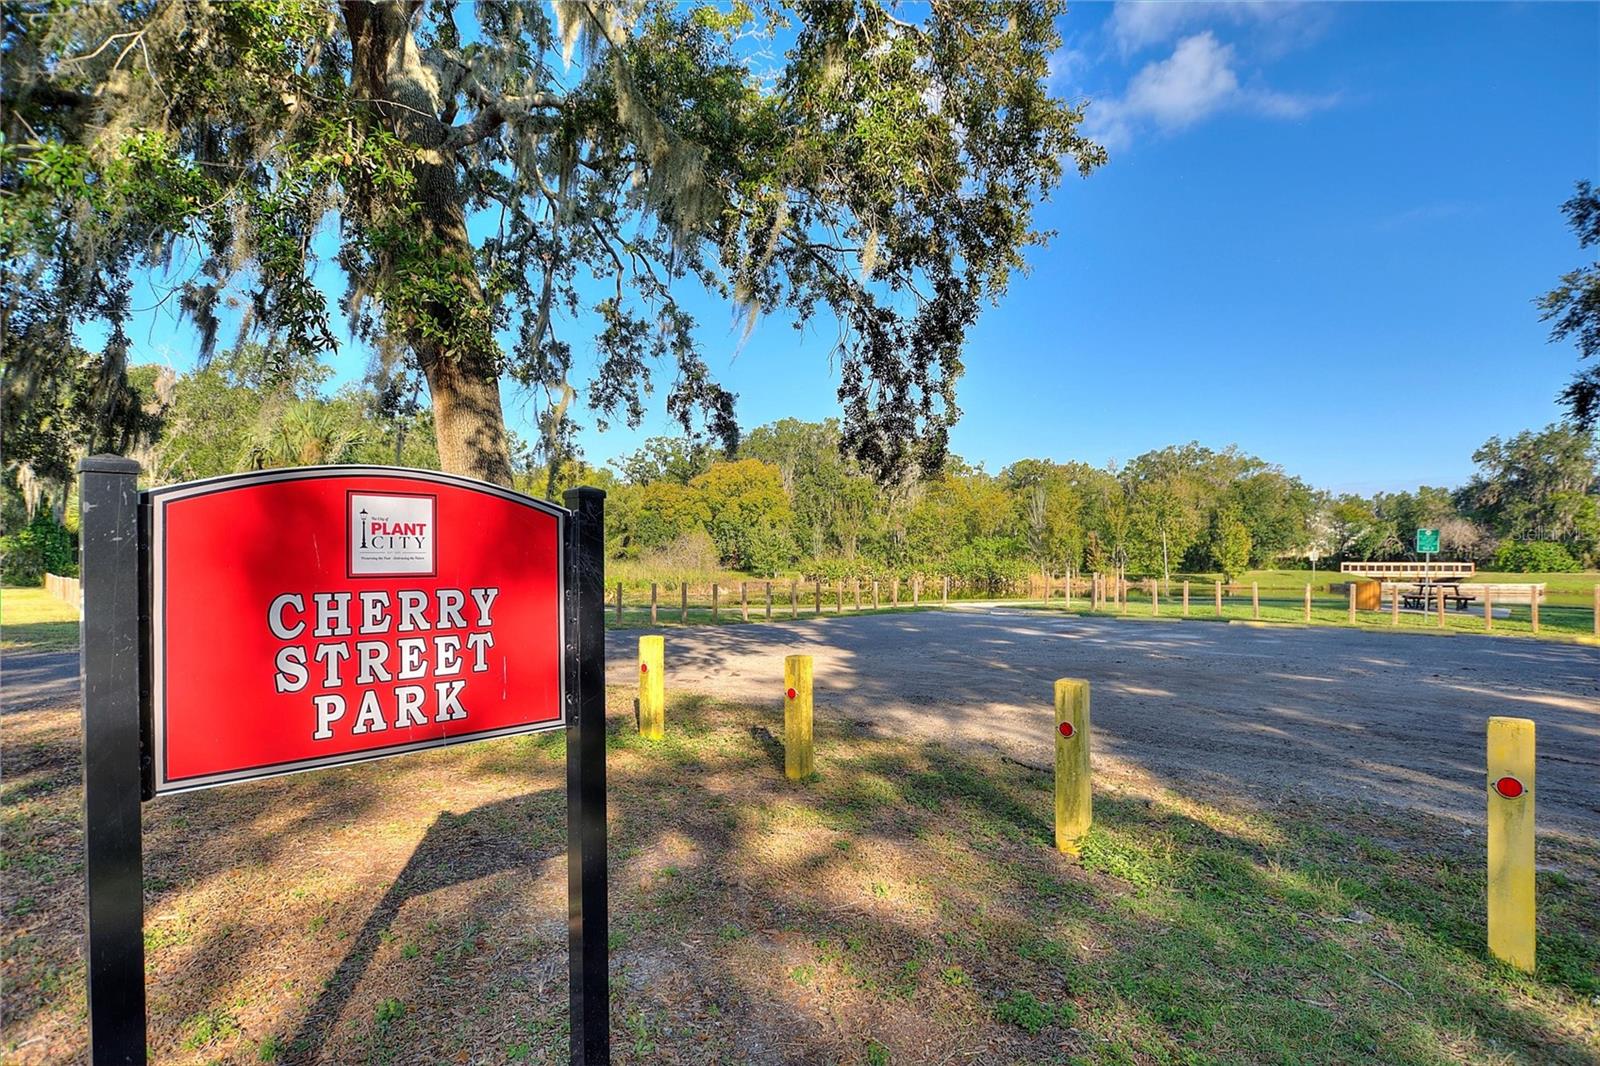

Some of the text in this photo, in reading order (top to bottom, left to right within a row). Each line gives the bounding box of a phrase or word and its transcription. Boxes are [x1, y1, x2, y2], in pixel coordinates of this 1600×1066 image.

[371, 522, 426, 536] PLANT
[371, 536, 425, 549] CITY
[268, 587, 499, 640] CHERRY
[274, 631, 495, 693] STREET
[312, 679, 468, 740] PARK
